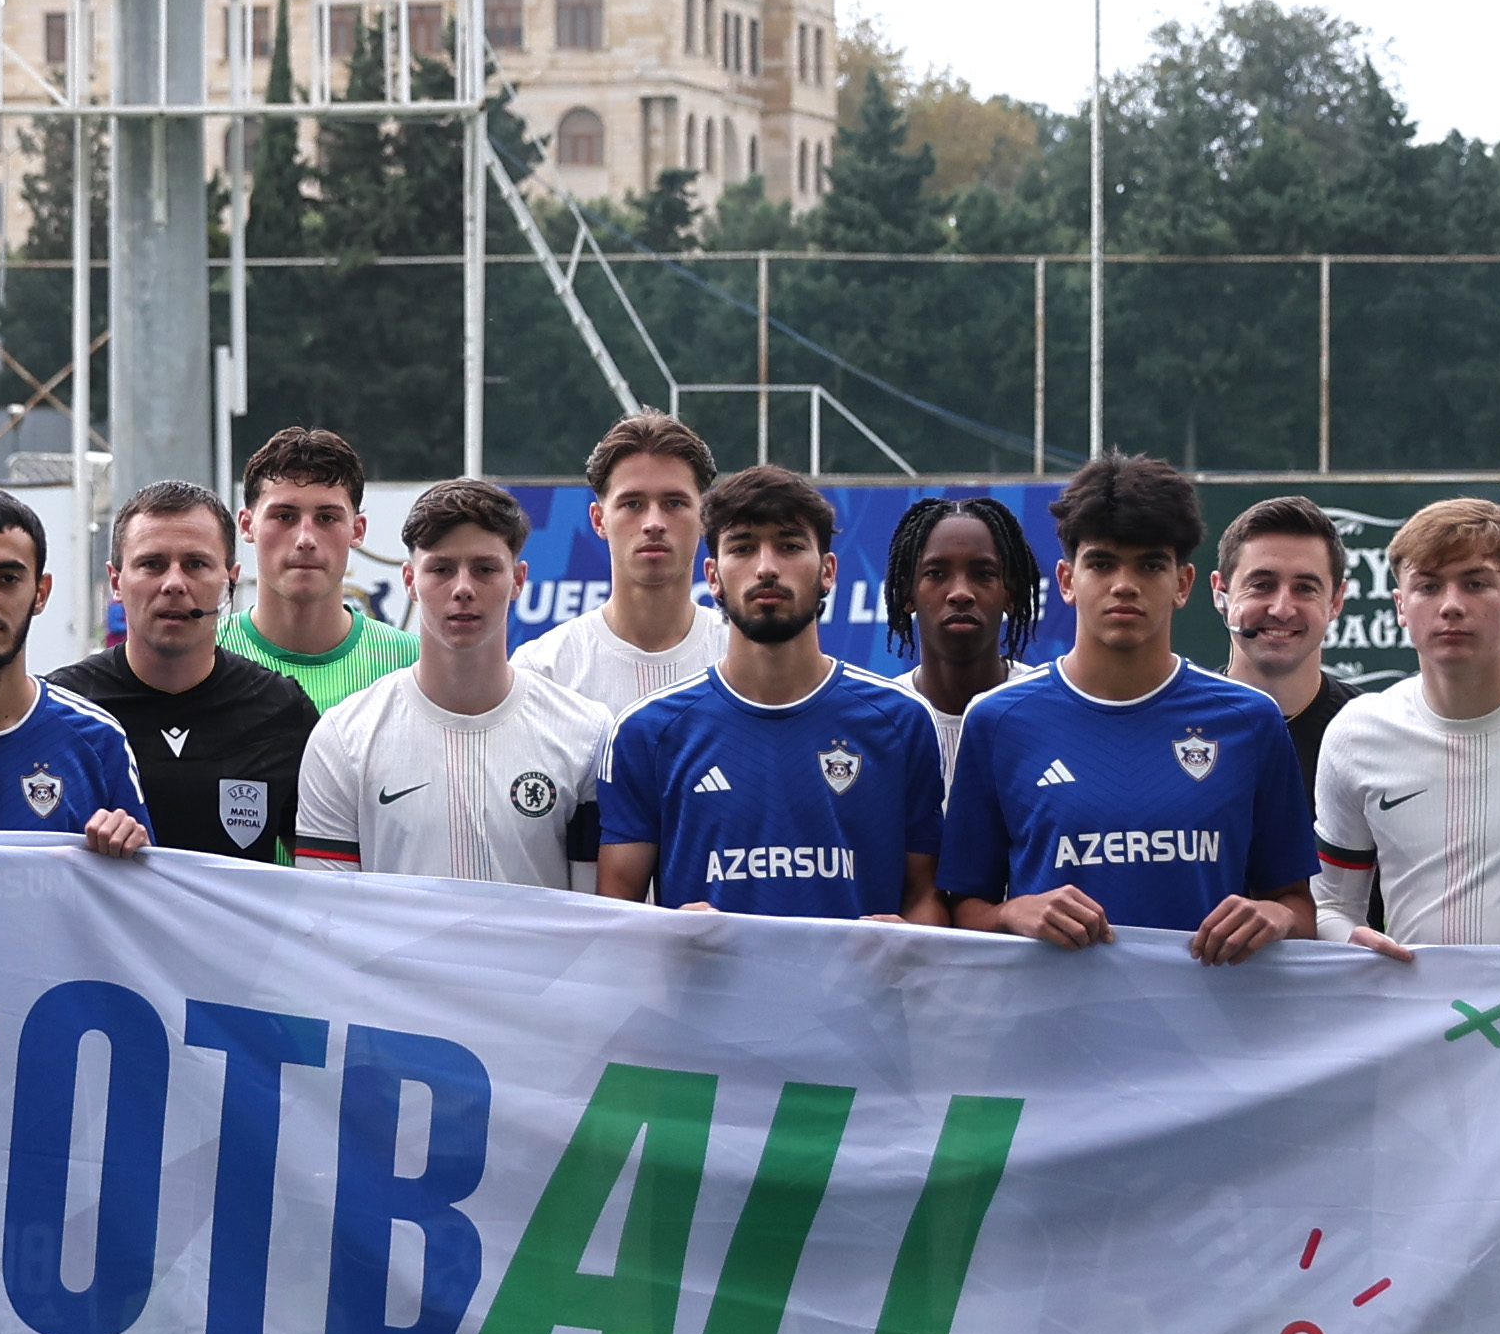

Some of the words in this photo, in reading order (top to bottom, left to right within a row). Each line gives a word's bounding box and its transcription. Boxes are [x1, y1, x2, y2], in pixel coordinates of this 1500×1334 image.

[515, 580, 609, 625] UEF
[229, 786, 258, 801] UEFA
[226, 817, 261, 828] OFFICIAL
[230, 807, 259, 817] MATCH
[1054, 830, 1220, 868] AZERSUN
[705, 846, 855, 883] AZERSUN
